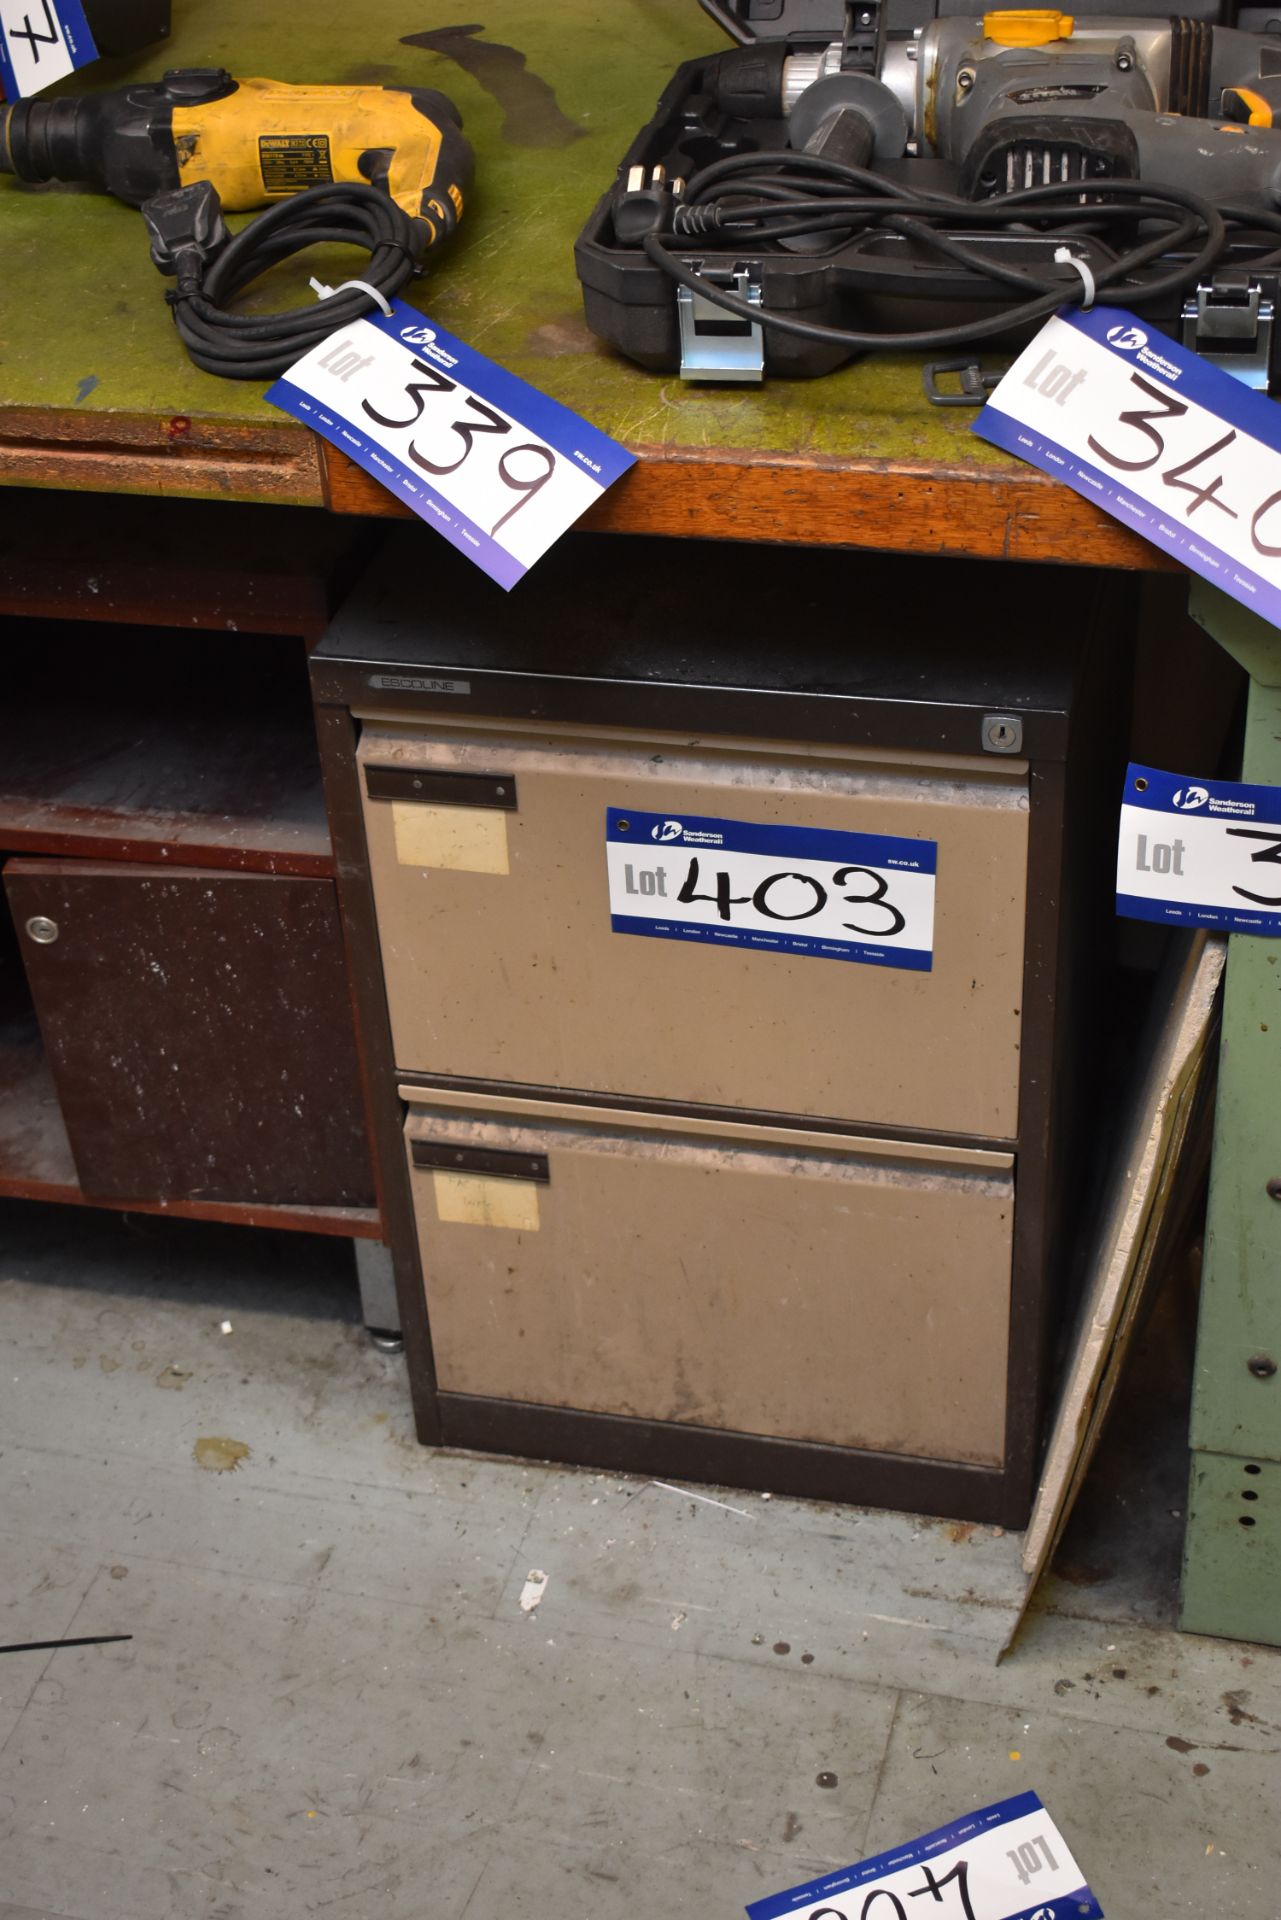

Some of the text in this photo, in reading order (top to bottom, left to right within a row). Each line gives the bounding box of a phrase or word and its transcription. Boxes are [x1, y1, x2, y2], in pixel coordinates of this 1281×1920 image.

[422, 346, 454, 369] Weatherall
[427, 342, 459, 365] Sanderson
[1140, 346, 1182, 375] Sanderson
[1022, 348, 1088, 406] Lot
[1136, 352, 1178, 381] Weatherall
[317, 339, 556, 538] Lot 339
[573, 450, 602, 474] sw.co.uk
[1018, 435, 1033, 447] Leeds
[1045, 451, 1065, 466] London
[1077, 470, 1103, 490] Newcastle
[1116, 496, 1146, 518] Manchester
[1158, 524, 1176, 538] Bristol
[1189, 545, 1219, 568] Birmingham
[381, 678, 454, 691] ESCOLINE
[1208, 797, 1255, 809] Sanderson
[1208, 804, 1255, 816] Weatherall
[683, 829, 723, 839] Sanderson
[683, 836, 723, 845] Weatherall
[887, 858, 919, 868] sw.co.uk
[1136, 834, 1185, 876] Lot
[624, 857, 906, 936] Lot 403
[1006, 1835, 1060, 1885] Lot
